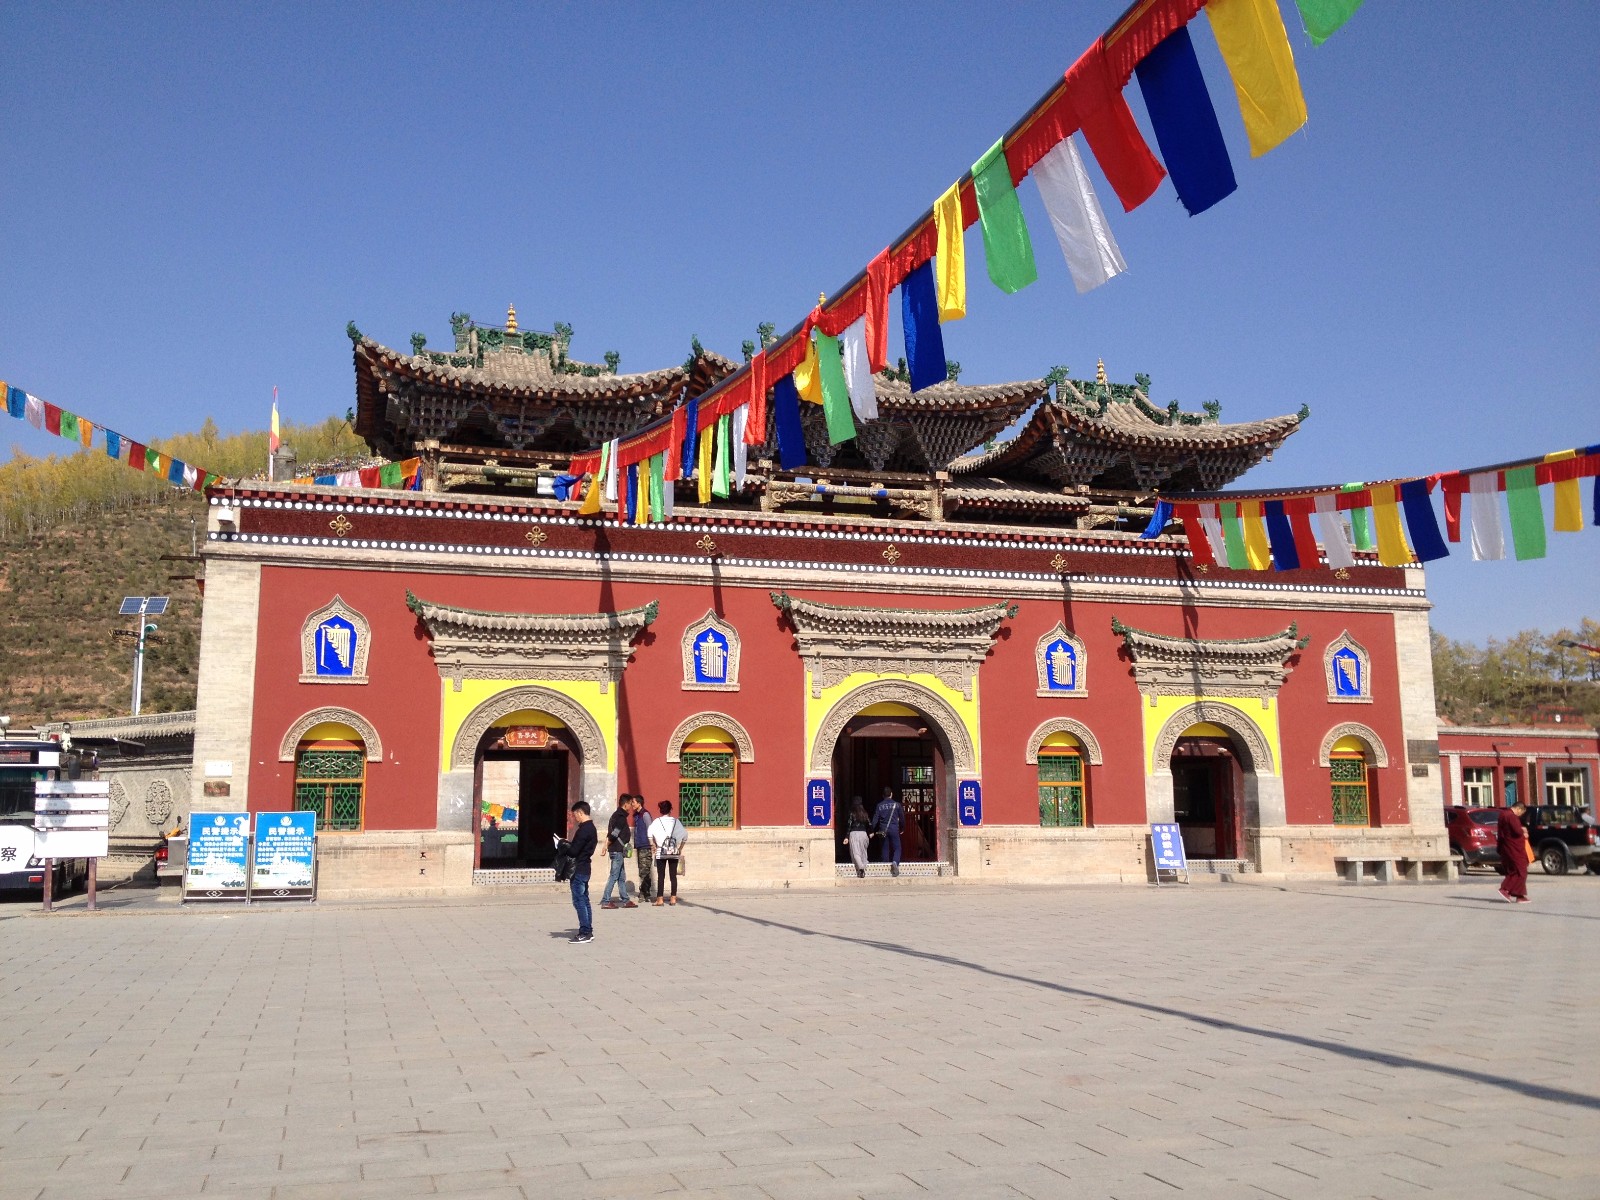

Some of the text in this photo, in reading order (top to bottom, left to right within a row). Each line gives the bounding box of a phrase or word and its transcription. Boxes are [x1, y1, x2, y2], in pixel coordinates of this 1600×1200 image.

[812, 785, 825, 820] 出口
[963, 786, 976, 820] 出口
[1, 846, 17, 862] 察
